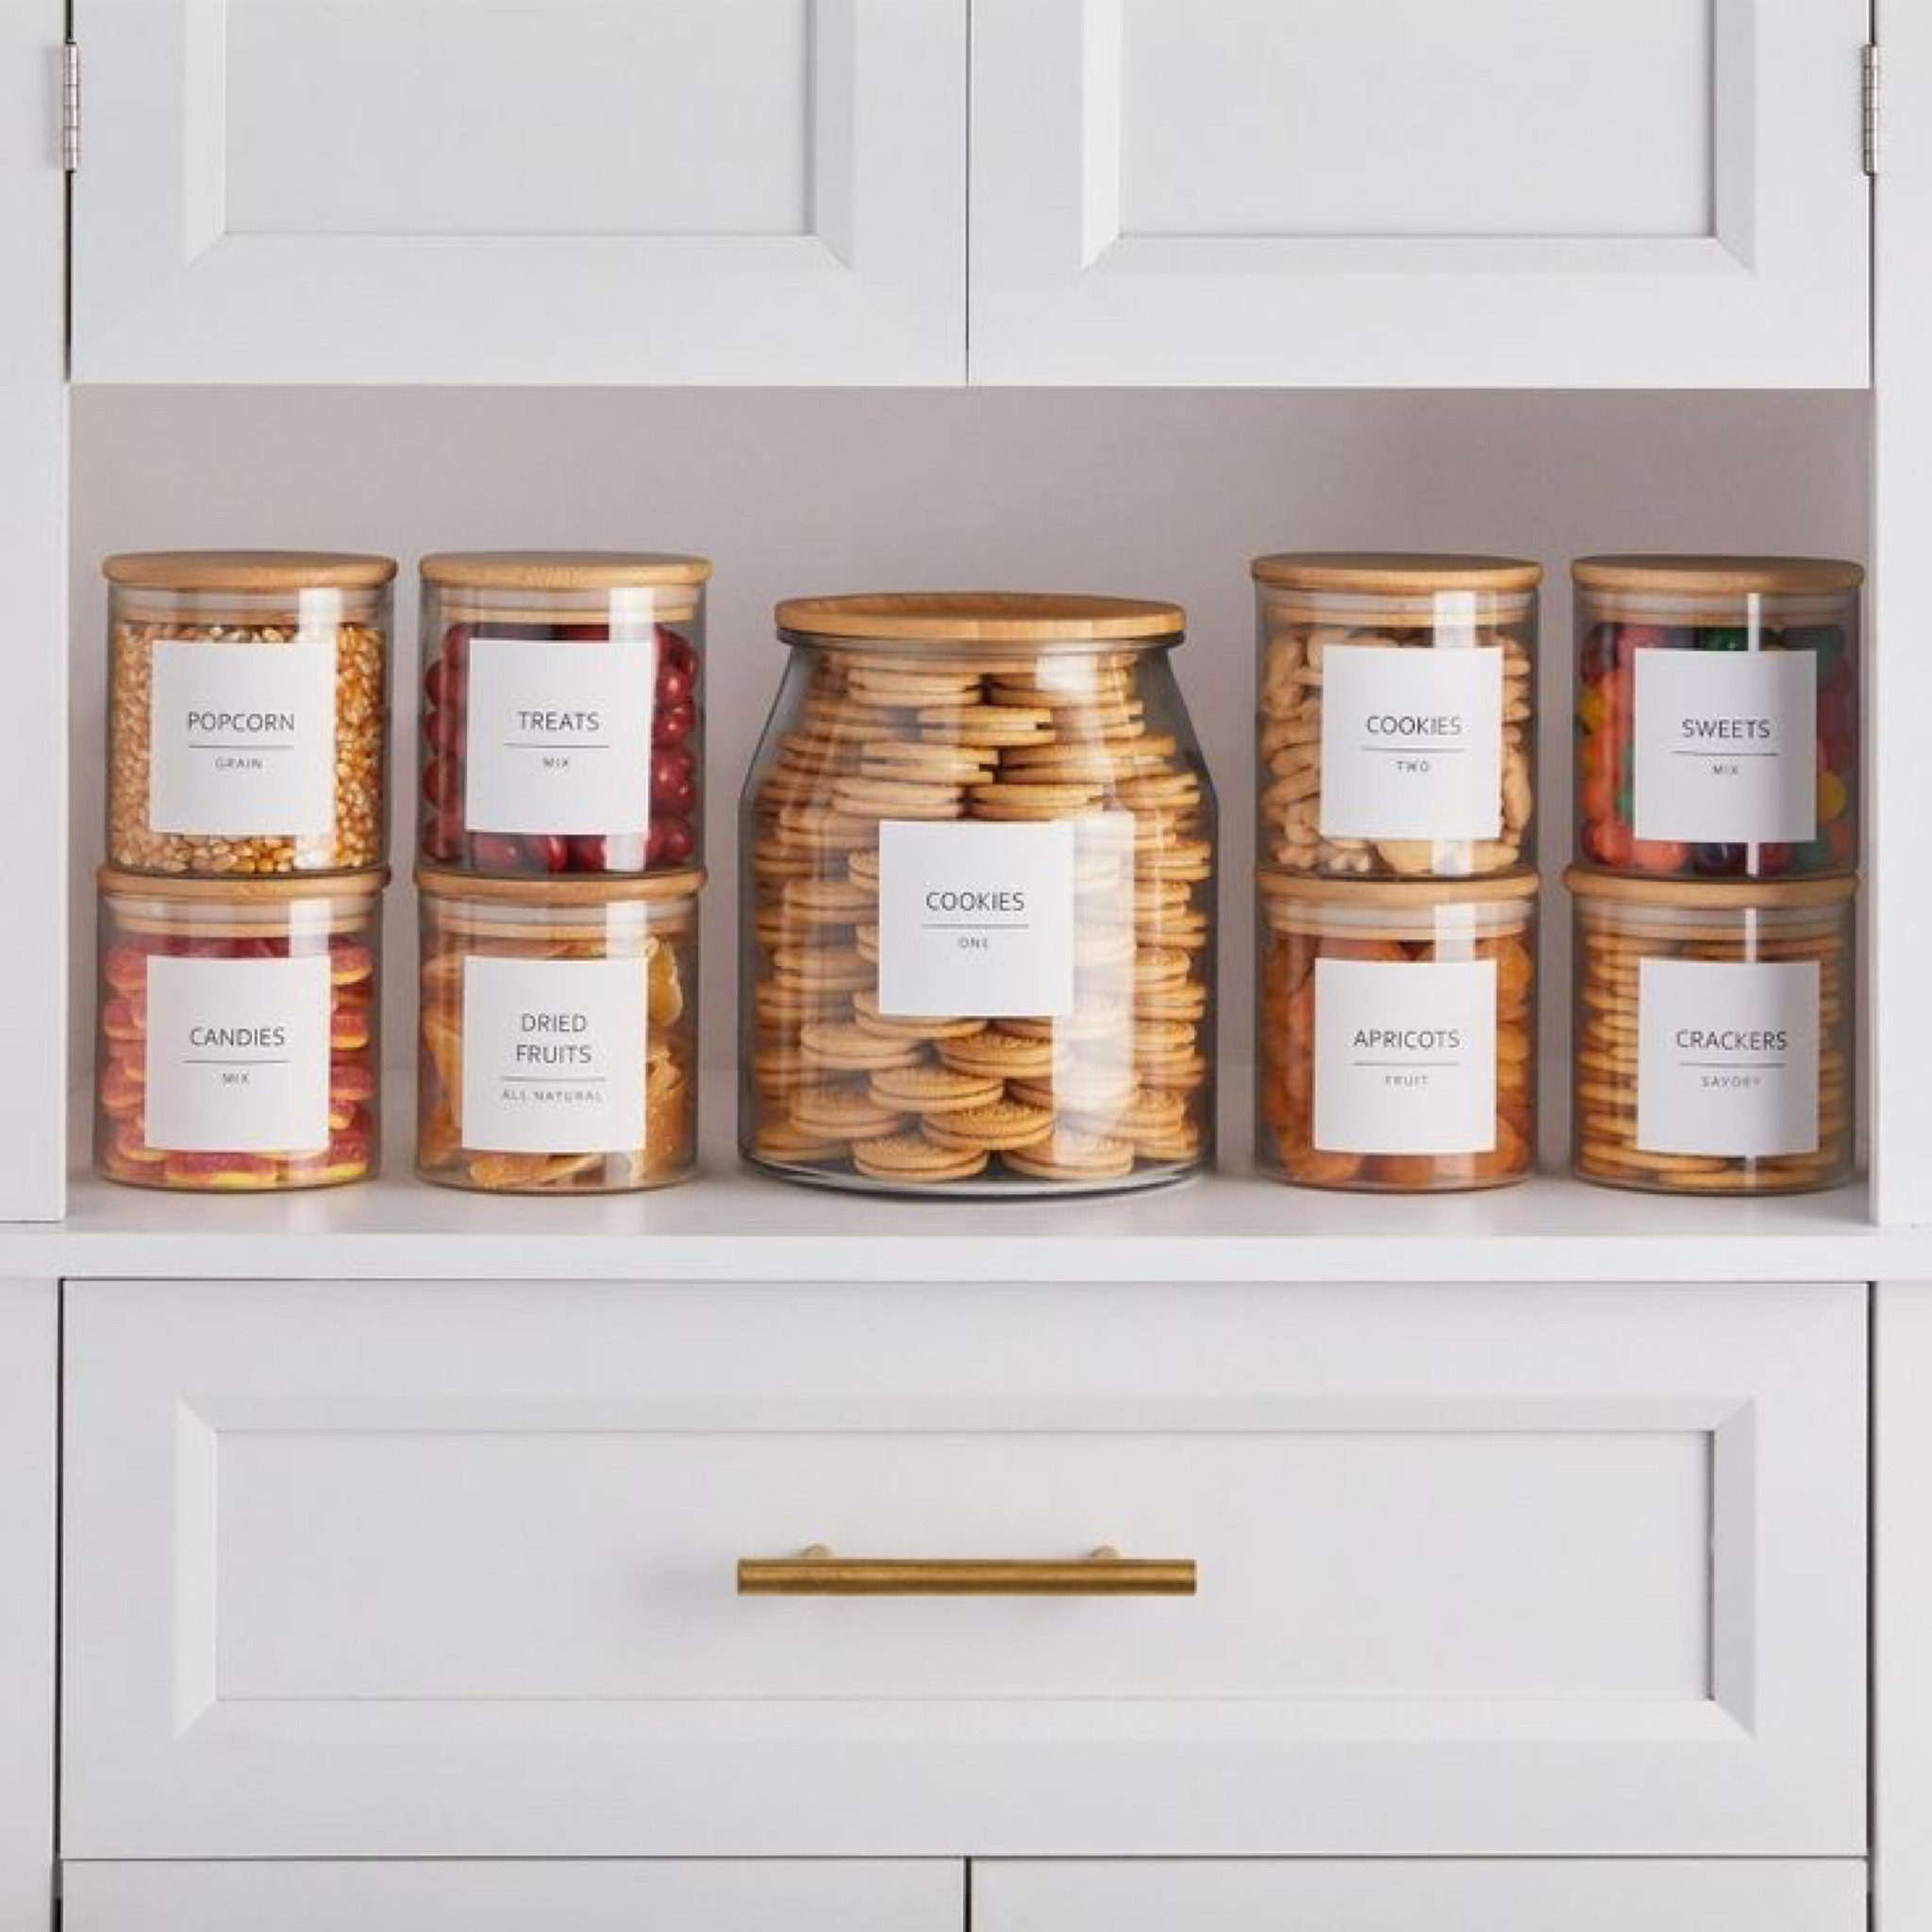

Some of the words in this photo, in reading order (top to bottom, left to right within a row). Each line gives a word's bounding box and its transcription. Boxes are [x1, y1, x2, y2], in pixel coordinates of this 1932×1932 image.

[188, 711, 295, 733] POPCORN
[516, 711, 600, 732] TREATS
[1365, 715, 1462, 736] COOKIES
[1681, 718, 1771, 739] SWEETS
[1396, 759, 1429, 773] TWO
[925, 891, 1025, 912] COOKIES
[521, 1012, 589, 1033] DRIED
[189, 1026, 285, 1047] CANDIES
[1352, 1028, 1461, 1050] APRICOTS
[1675, 1029, 1789, 1051] CRACKERS
[515, 1044, 591, 1064] FRUITS
